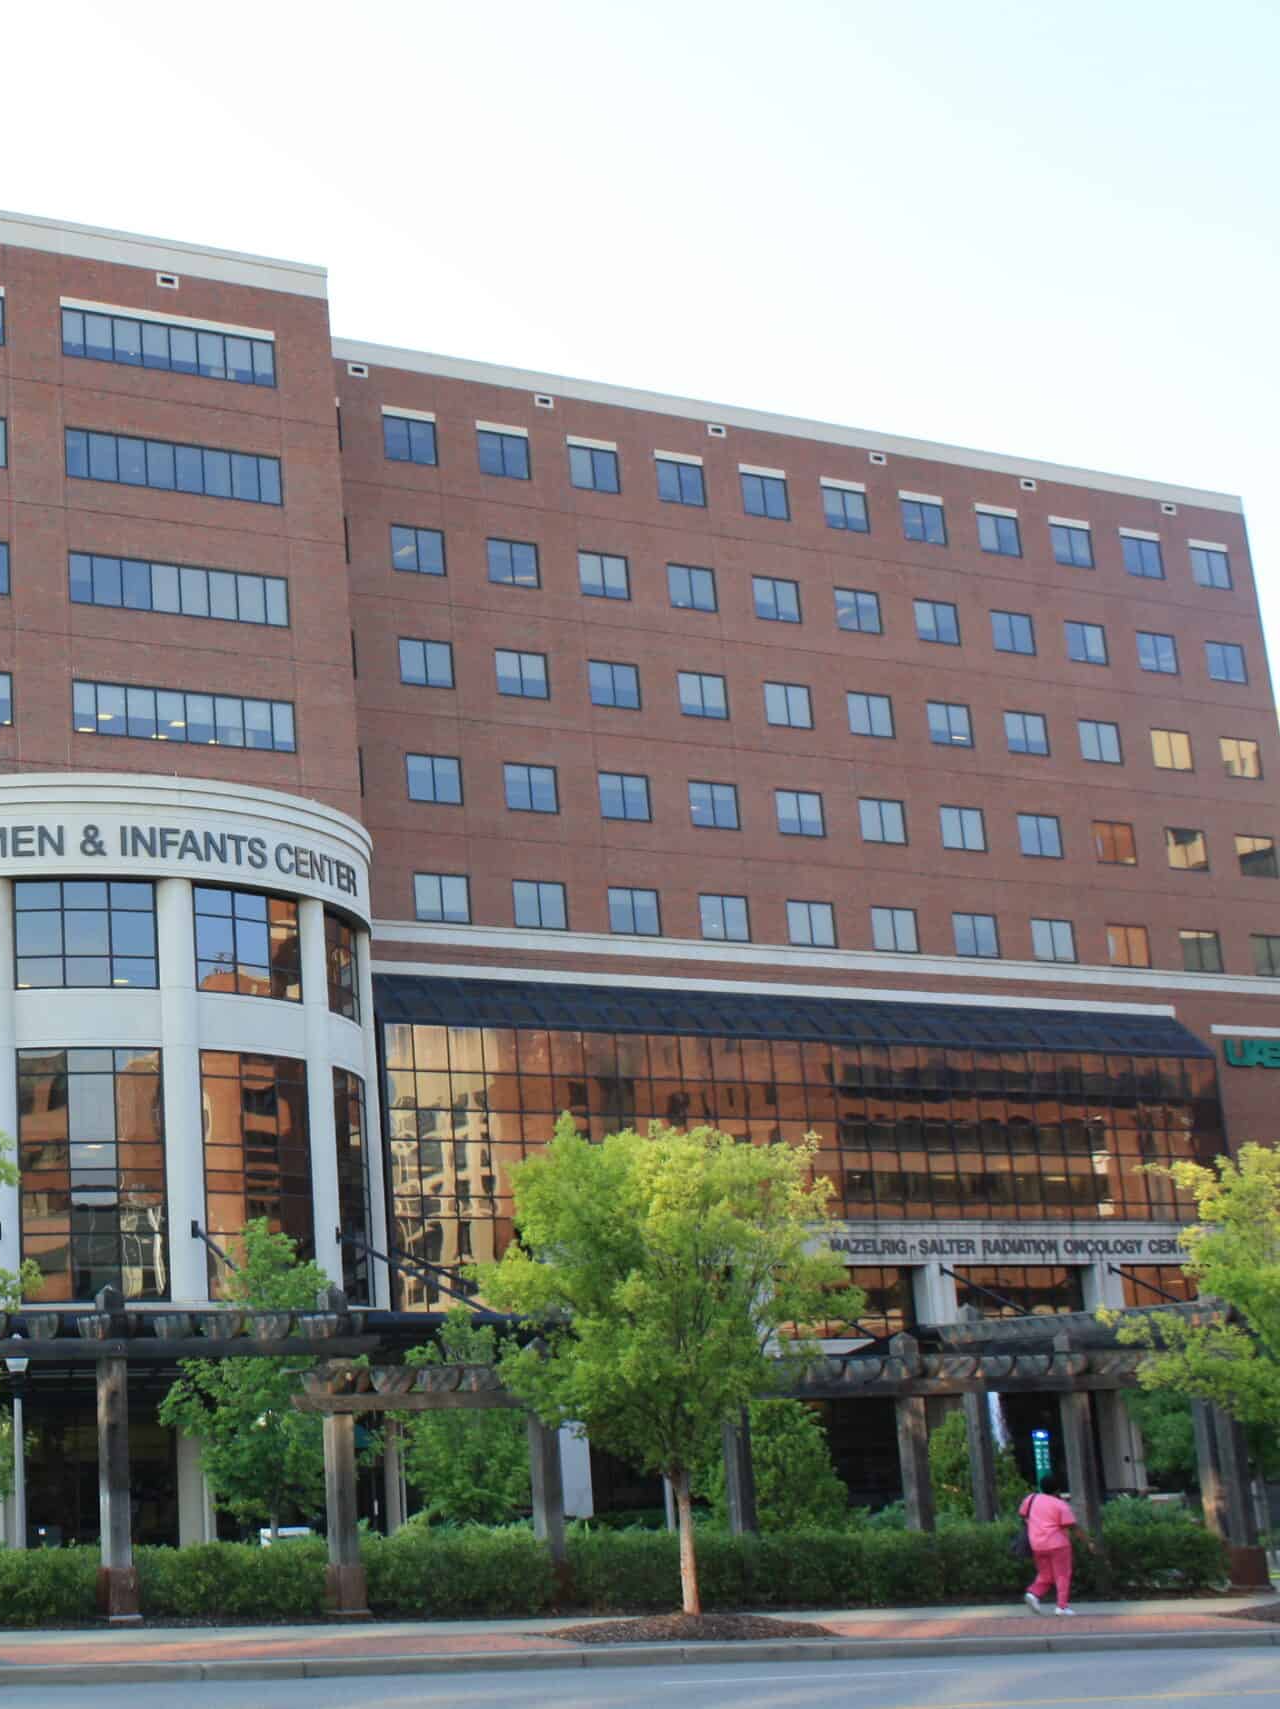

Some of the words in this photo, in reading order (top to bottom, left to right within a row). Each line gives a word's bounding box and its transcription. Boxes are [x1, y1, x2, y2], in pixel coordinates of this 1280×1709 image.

[79, 824, 108, 858] &
[119, 825, 268, 869] INFANTS
[275, 842, 359, 897] CENTER
[982, 1238, 1058, 1255] RADIATION
[1063, 1238, 1143, 1255] ONCOLOGY
